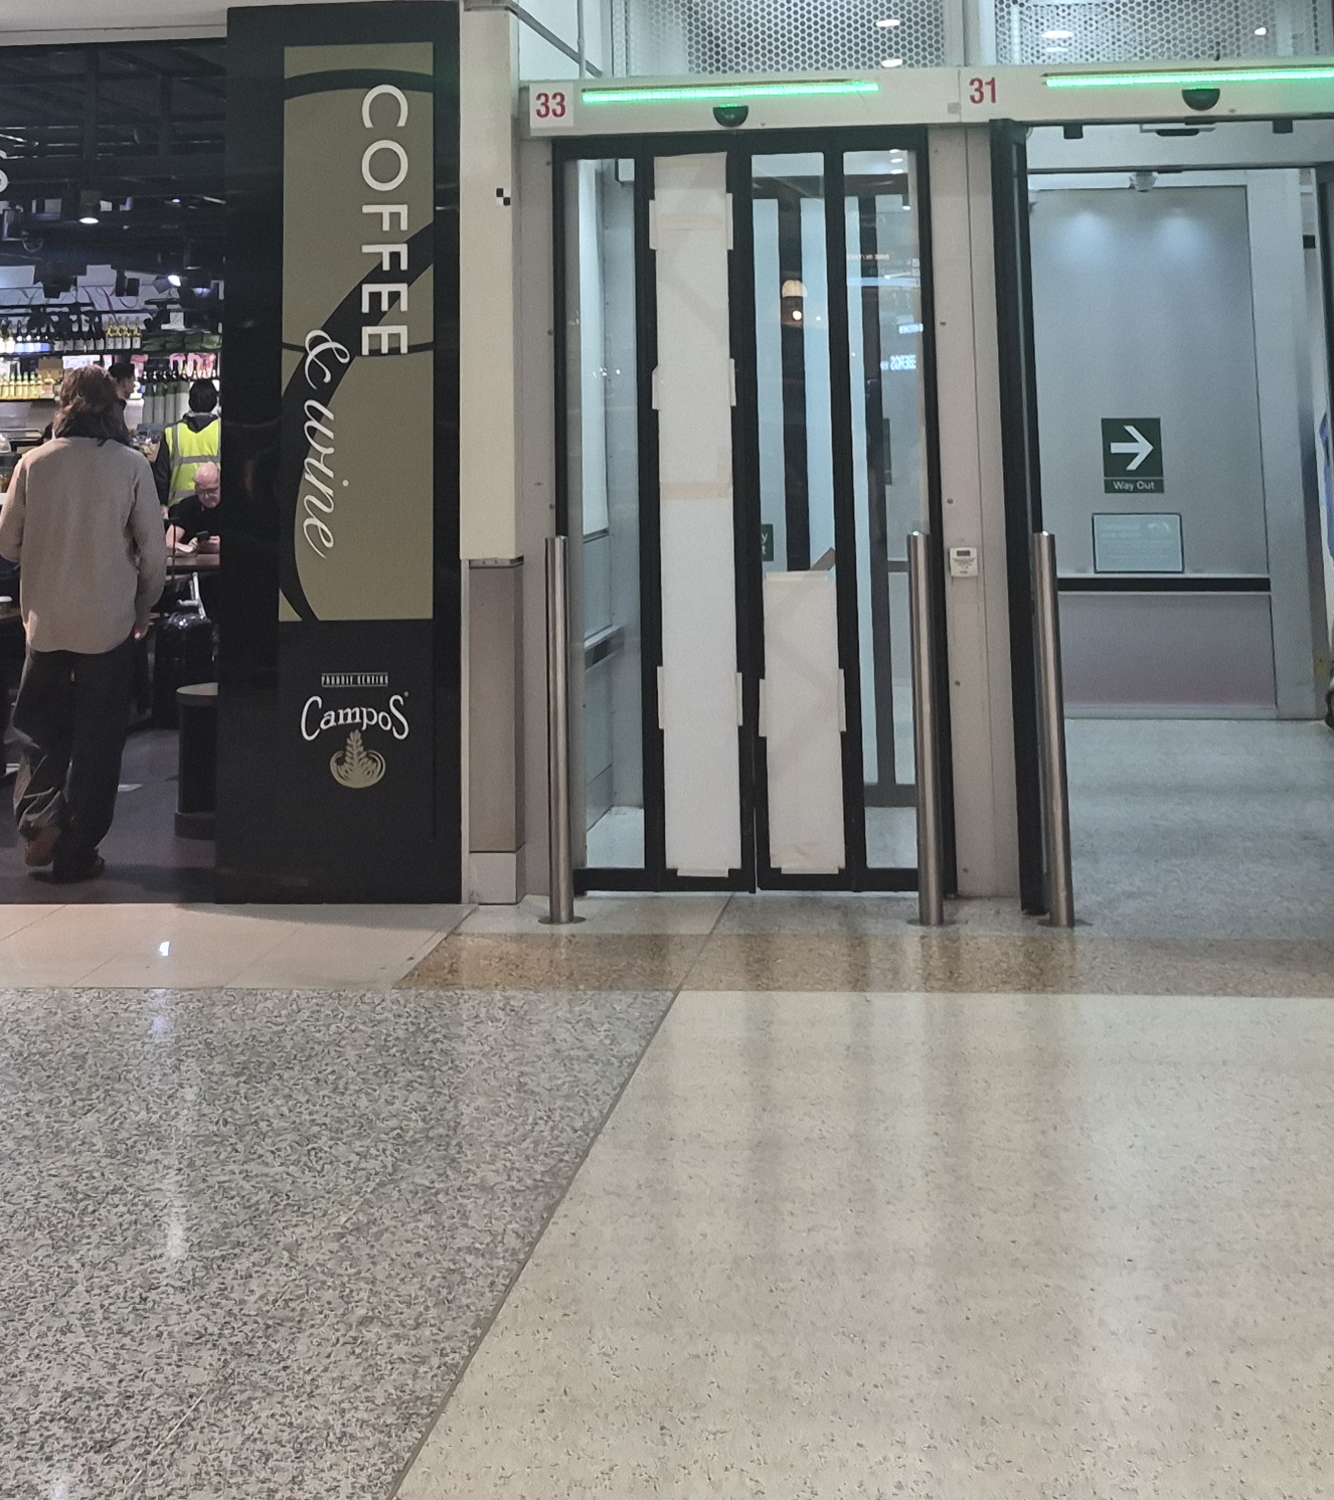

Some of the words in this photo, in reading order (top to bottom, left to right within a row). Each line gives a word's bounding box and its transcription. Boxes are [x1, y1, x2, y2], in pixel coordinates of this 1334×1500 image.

[535, 92, 566, 118] 33
[969, 77, 997, 105] 31
[362, 84, 408, 357] COFFEE
[304, 329, 350, 390] &
[303, 400, 349, 559] wine
[1113, 480, 1134, 492] Way
[1136, 480, 1155, 490] Out
